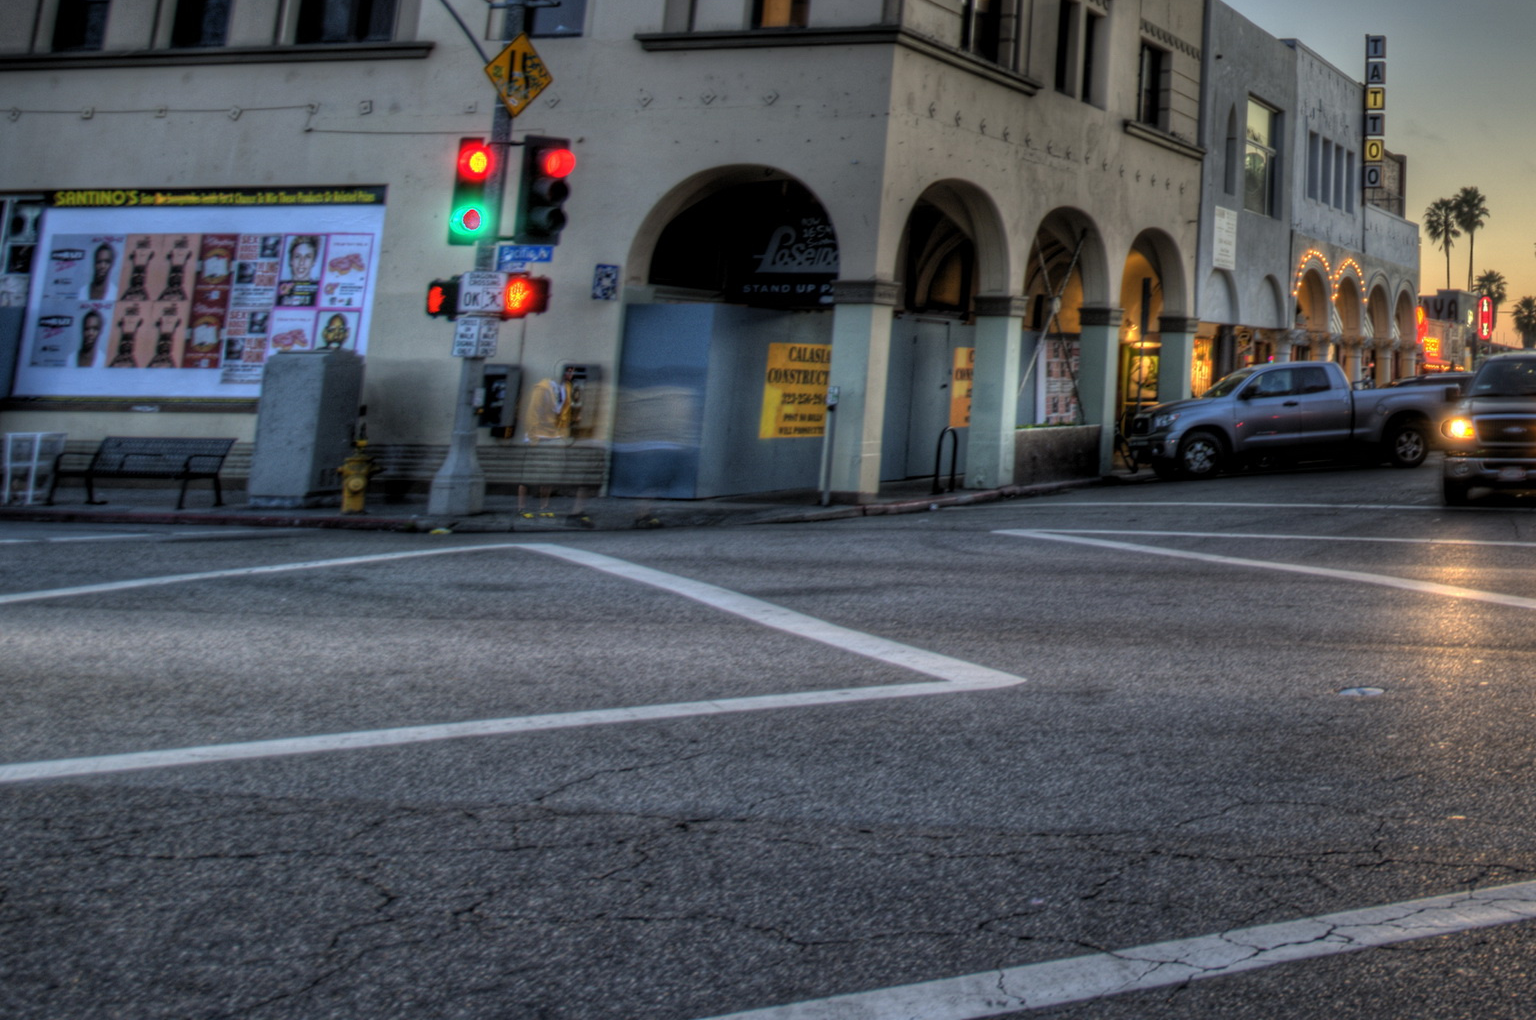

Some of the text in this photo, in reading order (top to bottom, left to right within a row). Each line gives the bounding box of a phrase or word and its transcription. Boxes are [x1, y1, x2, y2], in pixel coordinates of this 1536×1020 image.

[1367, 38, 1381, 185] TATTOO
[54, 190, 139, 206] SANTINO'S
[743, 284, 790, 293] STAND
[796, 284, 816, 293] UP
[463, 291, 481, 307] OK
